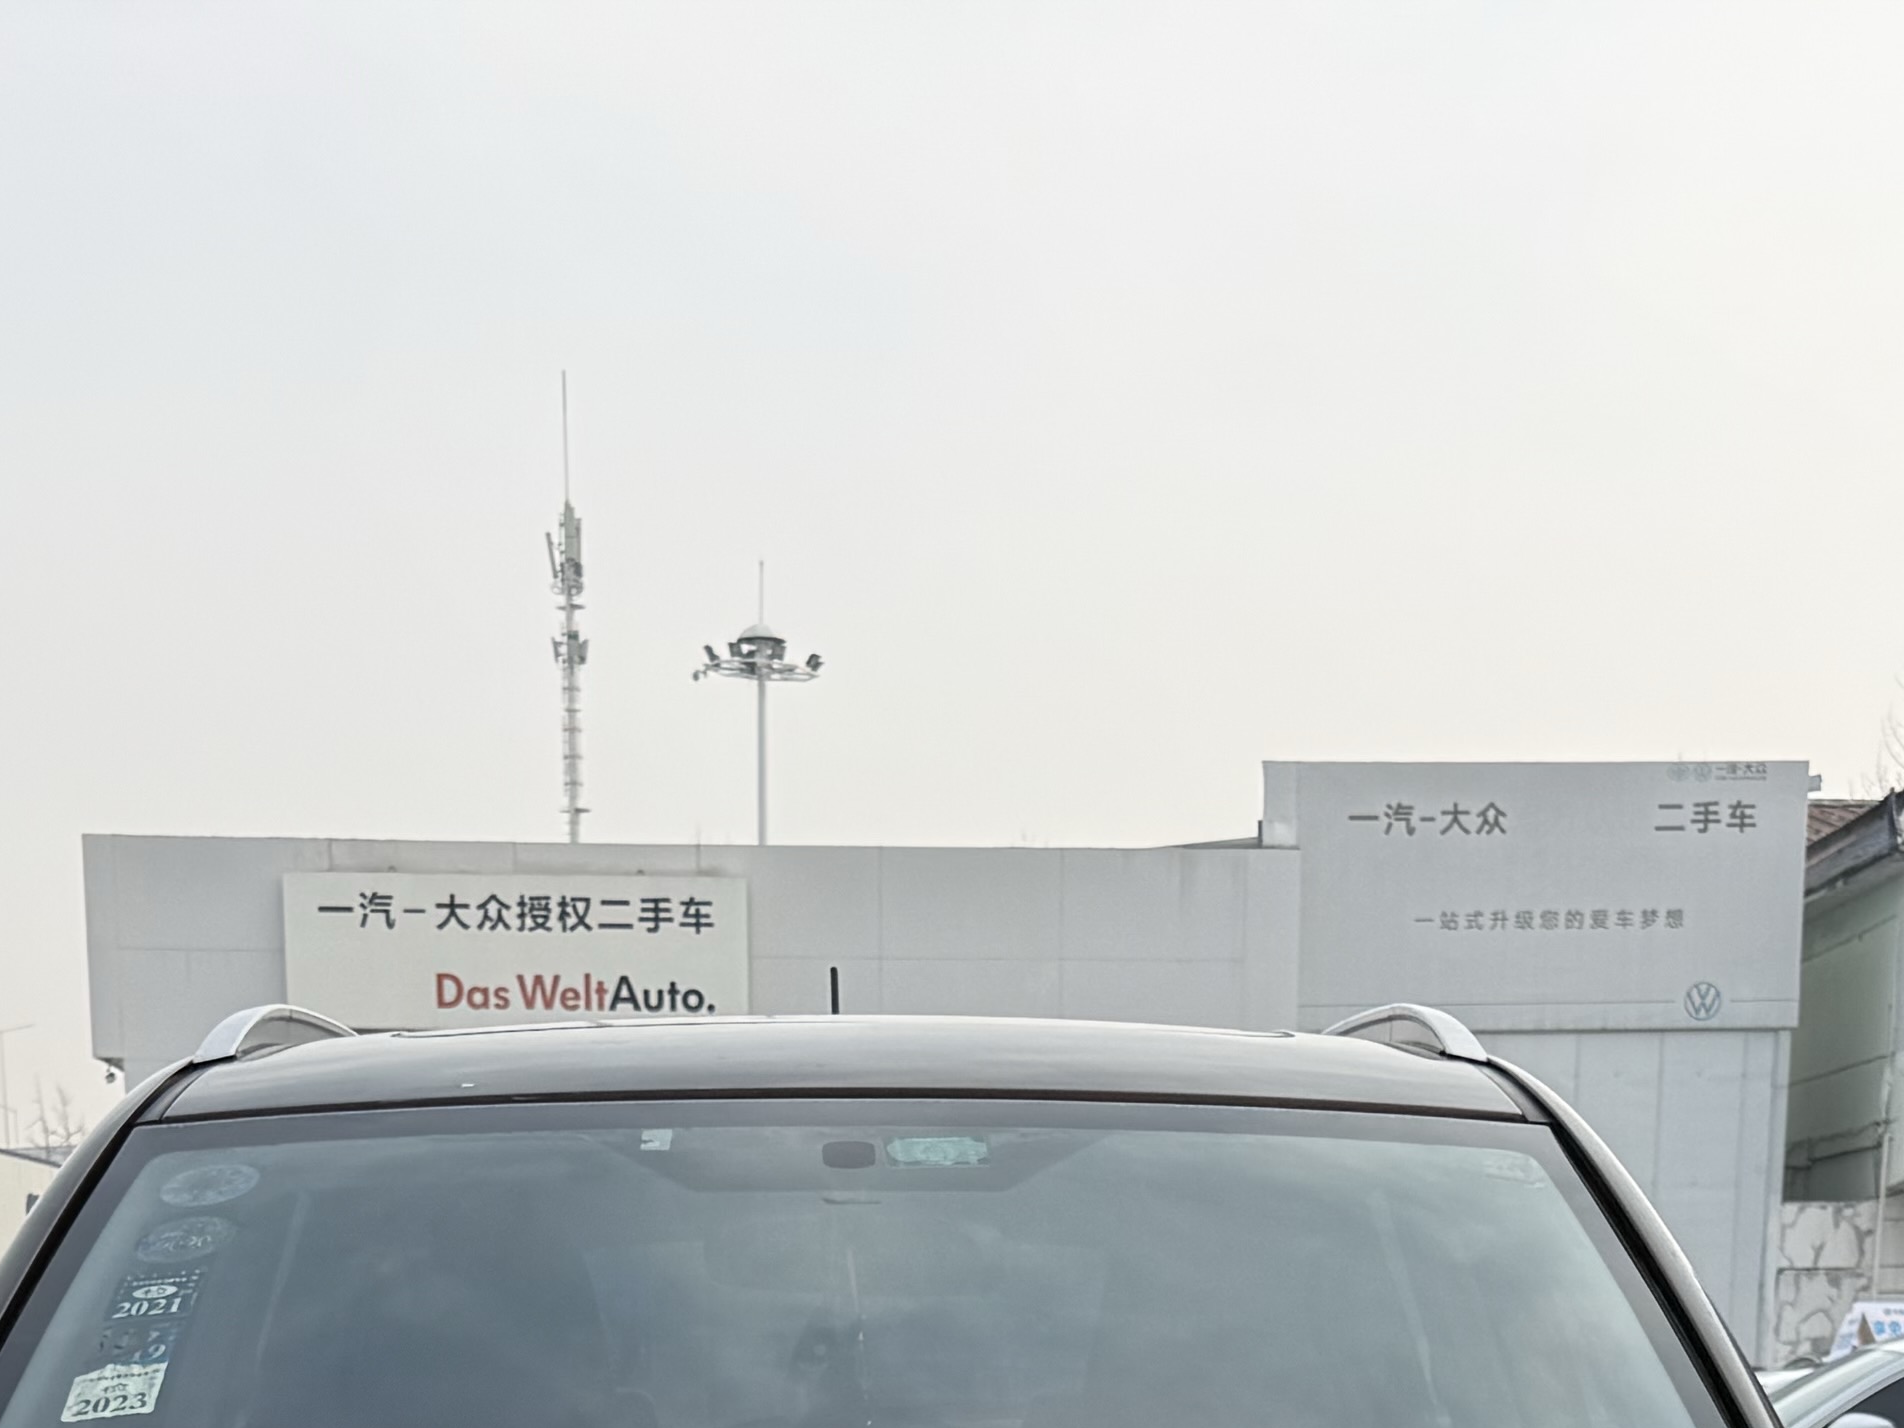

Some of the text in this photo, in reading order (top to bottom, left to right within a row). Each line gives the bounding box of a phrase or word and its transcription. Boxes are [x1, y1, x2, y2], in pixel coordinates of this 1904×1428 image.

[1348, 800, 1757, 836] 一汽-大众 二手车
[317, 891, 715, 935] 一汽-大众授权二手车
[435, 973, 510, 1011] Das
[112, 1298, 183, 1319] 2021
[69, 1392, 148, 1417] 2023
